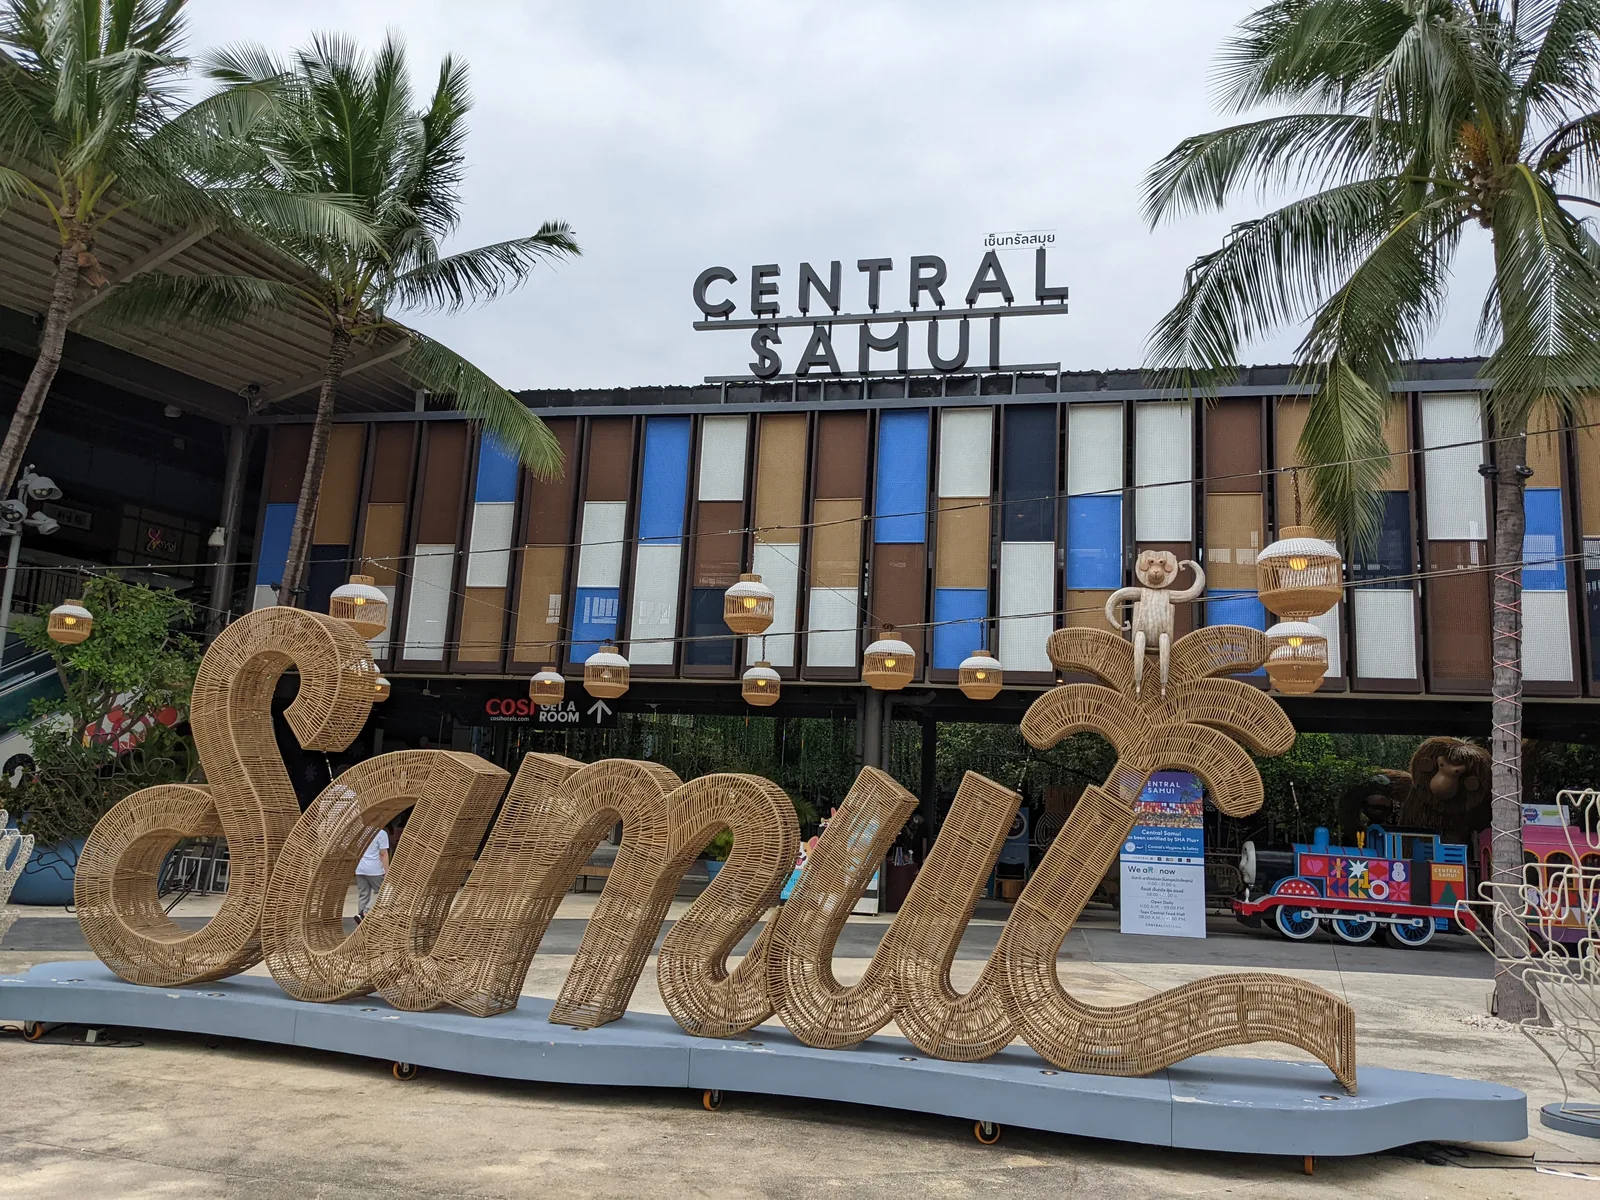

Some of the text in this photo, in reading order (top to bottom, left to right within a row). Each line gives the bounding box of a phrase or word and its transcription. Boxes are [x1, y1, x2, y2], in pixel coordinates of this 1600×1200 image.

[984, 233, 1056, 247] เซ็นทรัลสมุย
[692, 253, 1069, 318] CENTRAL
[748, 316, 1001, 380] SAMUI
[485, 698, 535, 716] COSI
[567, 700, 576, 712] A
[539, 711, 580, 723] ROOM
[74, 605, 1357, 1096] Samui
[1127, 865, 1141, 873] We
